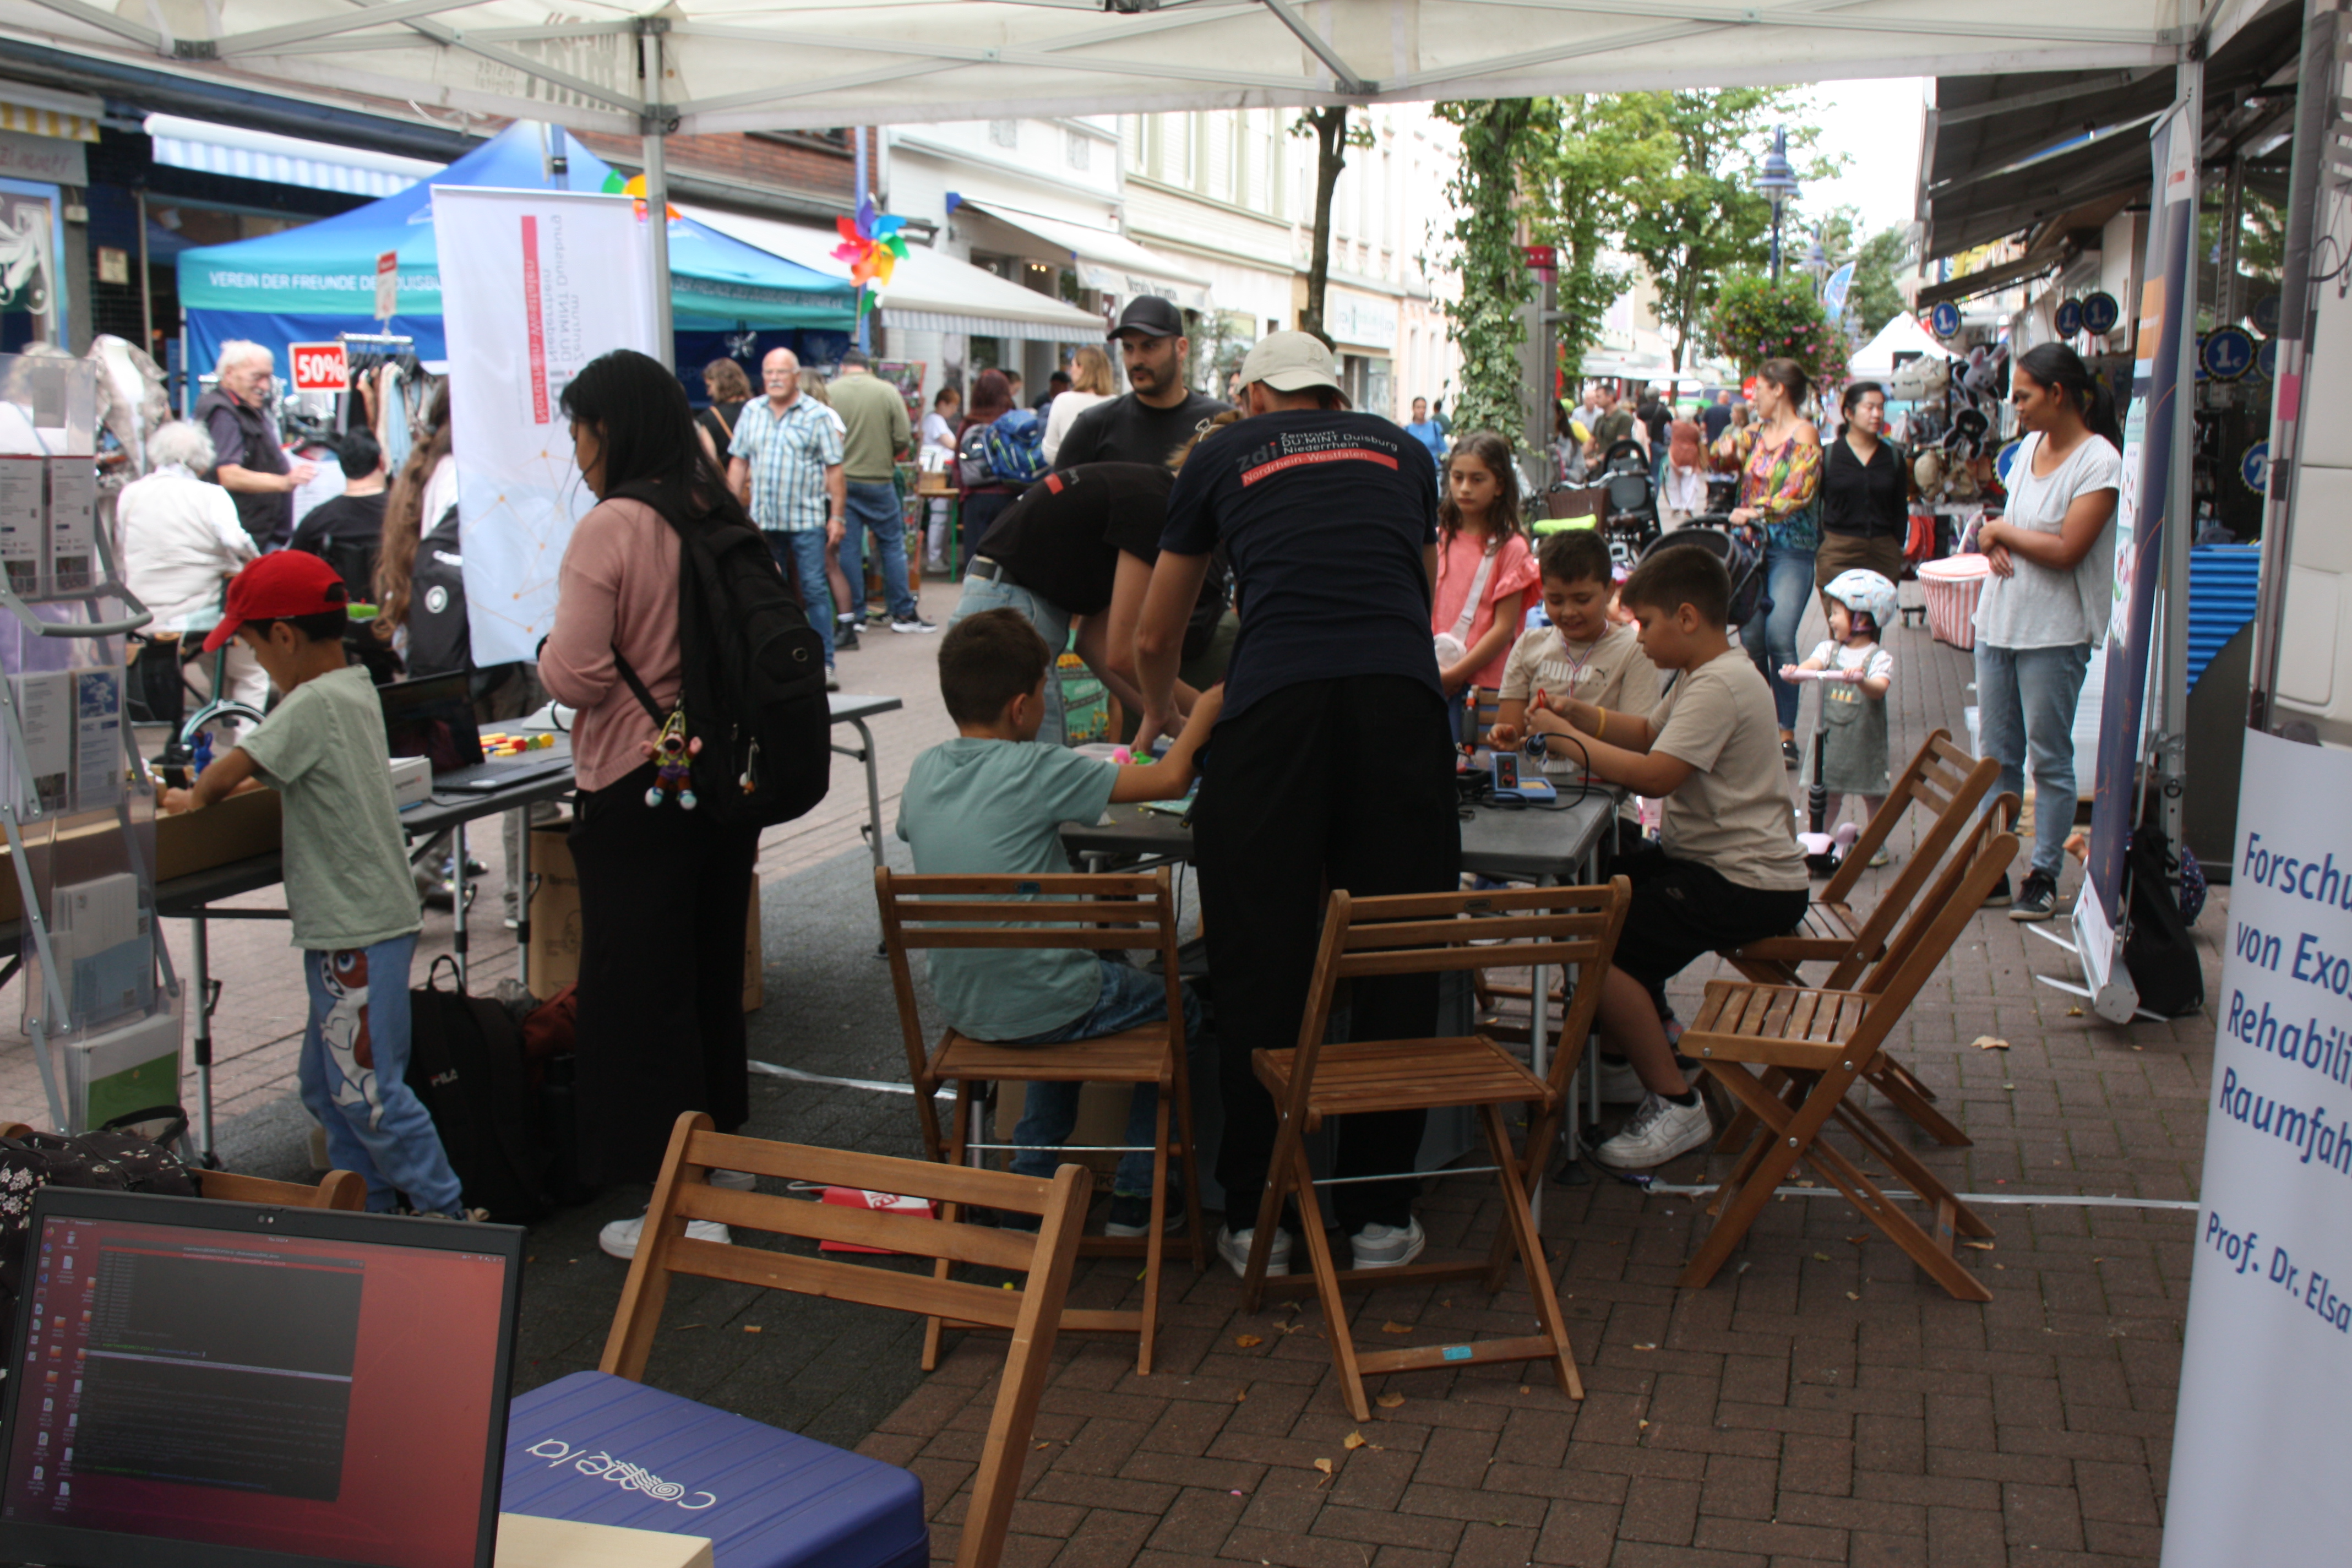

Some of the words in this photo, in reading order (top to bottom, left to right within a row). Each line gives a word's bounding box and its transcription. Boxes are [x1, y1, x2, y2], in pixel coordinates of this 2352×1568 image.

[210, 271, 258, 288] VEREIN
[261, 273, 290, 290] DER
[292, 274, 357, 291] FREUNDE
[360, 275, 377, 291] DE
[297, 353, 346, 384] 50%
[1280, 430, 1336, 440] Zentrum
[1283, 441, 1359, 455] Niederrhein
[1343, 433, 1398, 452] Duisburg
[1237, 441, 1278, 472] zdi
[1243, 450, 1368, 483] Nordrhein-Westfalen
[1538, 660, 1593, 682] PUMA
[2243, 831, 2352, 912] Forschu
[2236, 921, 2282, 972] von
[2291, 932, 2352, 1002] Exo
[430, 1069, 458, 1088] FILA
[2219, 1065, 2352, 1174] Raumfah
[2206, 1210, 2259, 1275] Prof.
[2269, 1245, 2299, 1297] Dr.
[2305, 1270, 2352, 1333] Elsa
